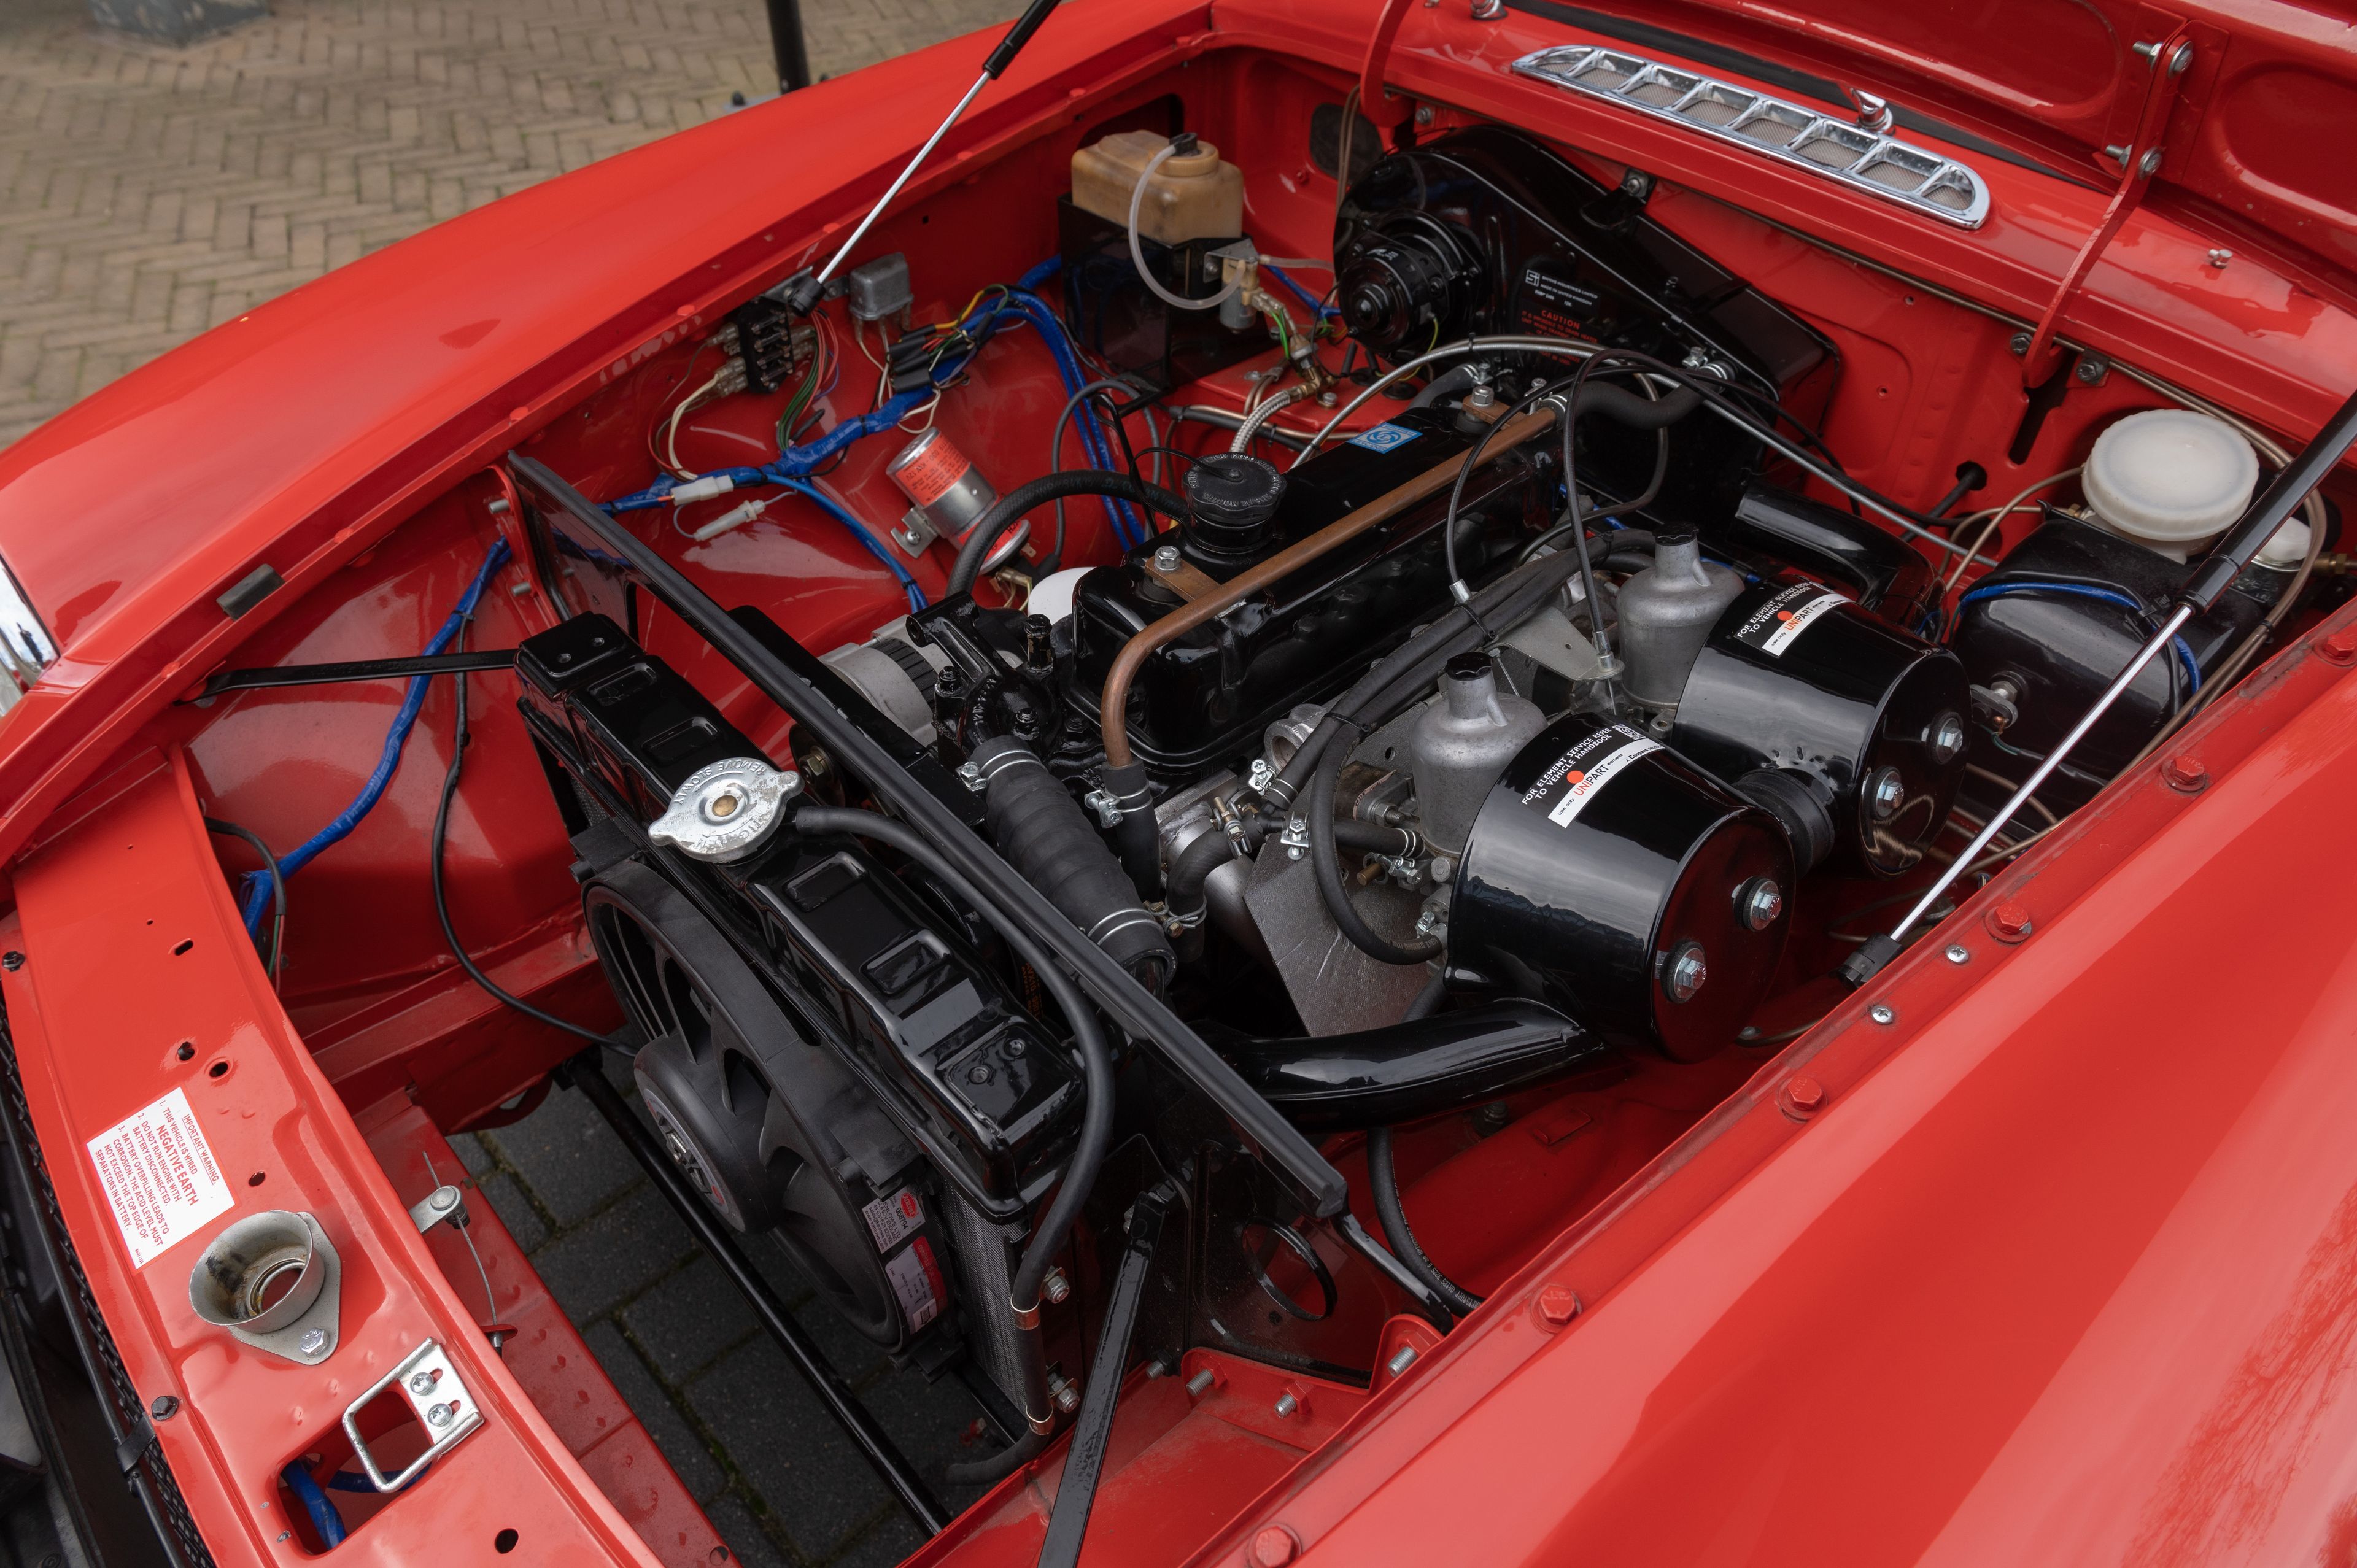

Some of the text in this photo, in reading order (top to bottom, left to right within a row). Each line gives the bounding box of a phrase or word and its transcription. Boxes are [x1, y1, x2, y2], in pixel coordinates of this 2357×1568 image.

[1542, 309, 1580, 330] CAUTION
[1352, 439, 1386, 450] LEYLAND
[1737, 624, 1751, 638] FOR
[1750, 600, 1776, 623] ELEMENT
[1775, 587, 1797, 601] SERVICE
[1749, 624, 1760, 633] TO
[1760, 602, 1784, 624] VEHICLE
[1783, 587, 1812, 602] HANDBOOK
[1784, 606, 1814, 631] UNIPART
[1522, 787, 1539, 805] FOR
[1537, 757, 1566, 788] ELEMENT
[1566, 737, 1595, 757] SERVICE
[1592, 727, 1612, 739] REFER
[1535, 734, 1612, 800] TO VEHICLE HANDBOOK
[1630, 747, 1649, 760] Coopers
[674, 759, 767, 805] REMOVE SLOWLY
[1558, 754, 1624, 816] use only UNIPART elements
[141, 1121, 150, 1131] DO
[145, 1130, 157, 1145] NOT
[163, 1107, 174, 1122] THIS
[169, 1121, 185, 1148] VEHICLE
[184, 1153, 197, 1174] WIRED
[133, 1126, 170, 1205] BATTERY DISCONNECTED.
[152, 1145, 163, 1160] RUN
[156, 1124, 199, 1205] NEGATIVE EARTH
[183, 1114, 219, 1183] IMPORTANT WARNING.
[95, 1149, 132, 1229] SEPARATORS IN BATTERY.
[122, 1132, 139, 1161] BATTERY
[134, 1161, 156, 1202] OVERFILLING
[151, 1201, 164, 1223] LEADS
[160, 1222, 169, 1234] TO
[158, 1159, 173, 1184] ENGINE
[104, 1143, 148, 1238] NOT EXCEED THE TOP EDGE OF
[113, 1138, 163, 1246] CORROSION. THE ACID LEVEL MUST
[169, 1182, 181, 1201] WITH
[904, 1195, 915, 1216] KENLOWE
[864, 1210, 885, 1251] www.kenlowe.com
[869, 1206, 889, 1247] sales@kenlowe.com
[875, 1210, 886, 1228] (0)1628
[883, 1227, 892, 1244] 823303
[883, 1200, 897, 1227] ENLOWE
[886, 1219, 897, 1241] ENGLAND
[894, 1207, 908, 1230] 068794
[1431, 1268, 1442, 1280] 3225
[1442, 1279, 1455, 1293] GATES
